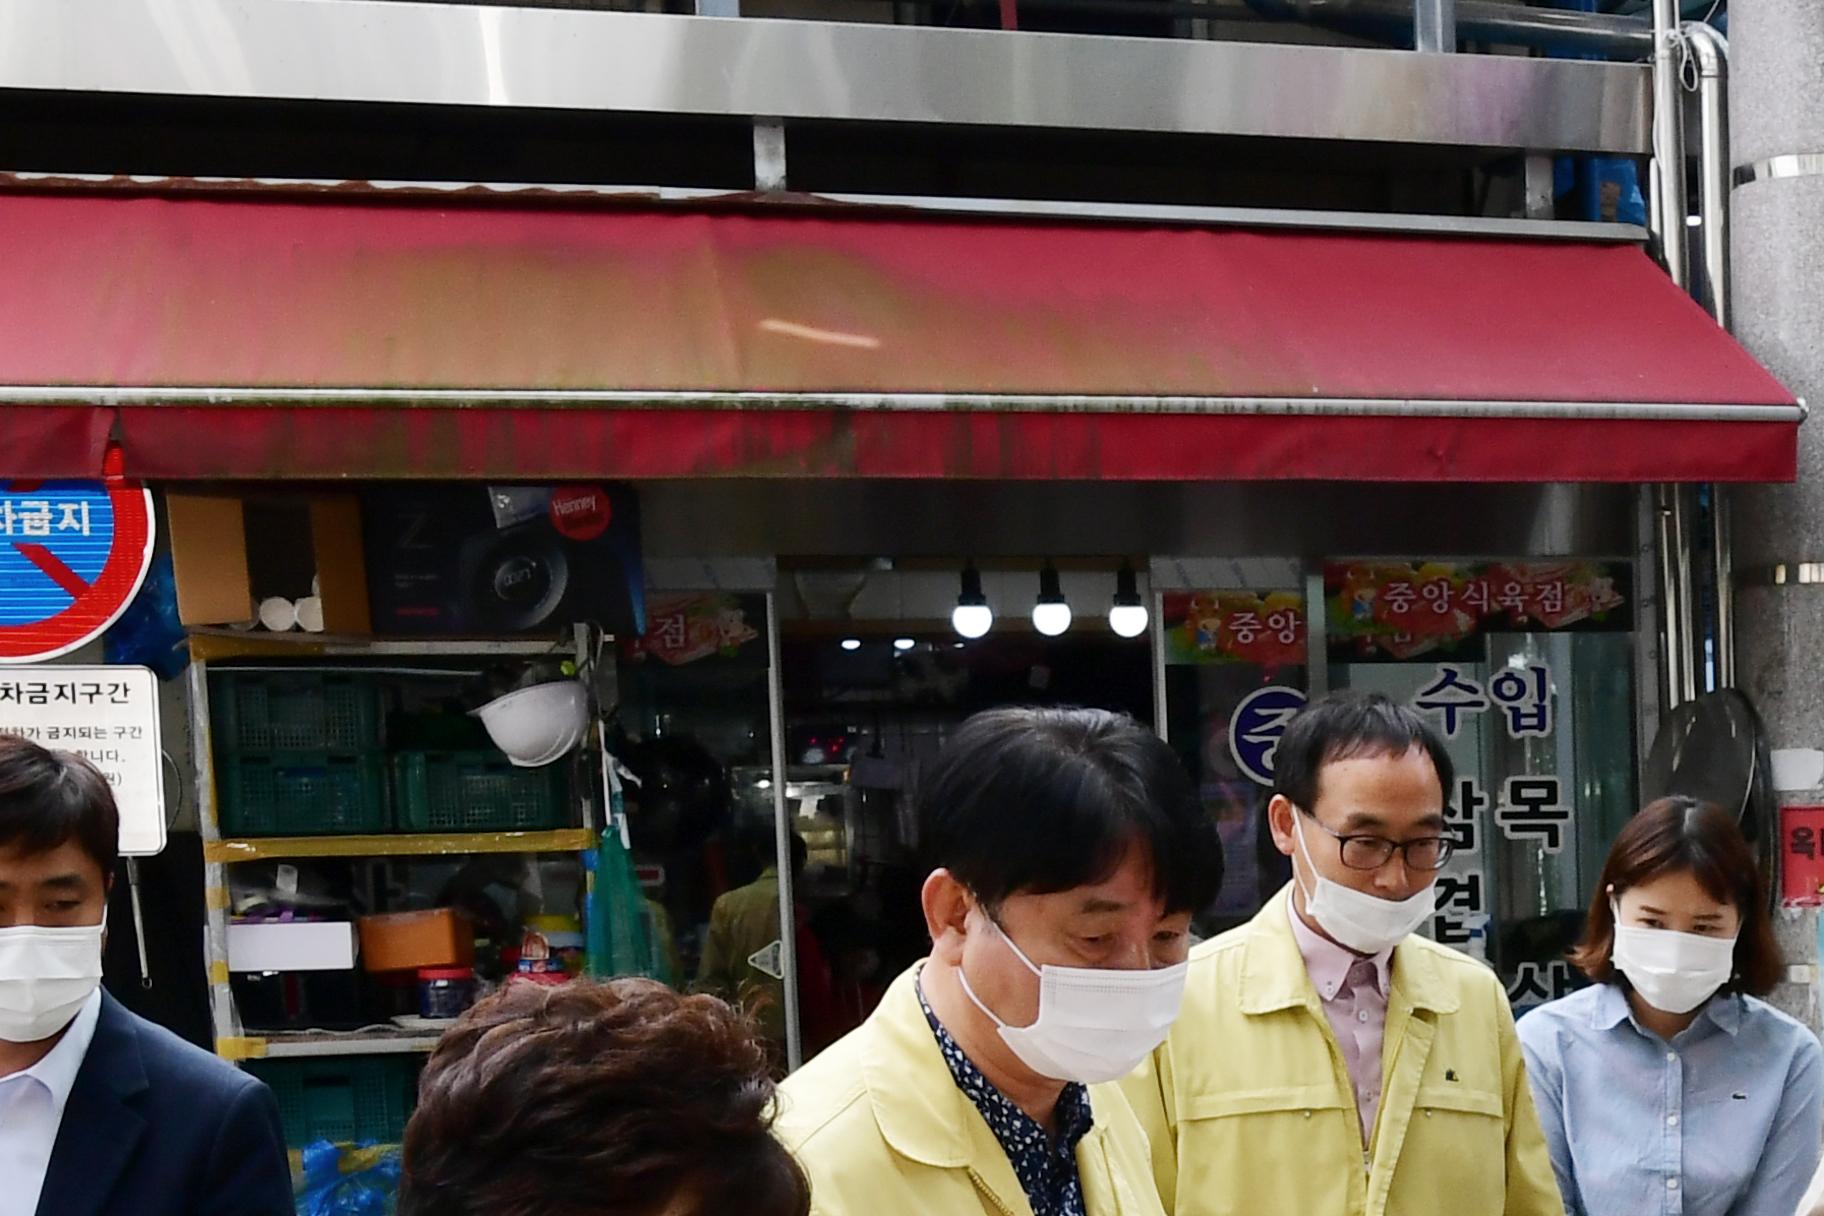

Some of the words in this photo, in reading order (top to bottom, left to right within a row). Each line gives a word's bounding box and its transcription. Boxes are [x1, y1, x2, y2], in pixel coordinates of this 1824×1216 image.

[1382, 580, 1567, 614] 중앙식육점
[1228, 611, 1301, 644] 중앙
[1414, 664, 1556, 740] 수입
[46, 725, 108, 741] 금지되는
[113, 725, 143, 740] 구간
